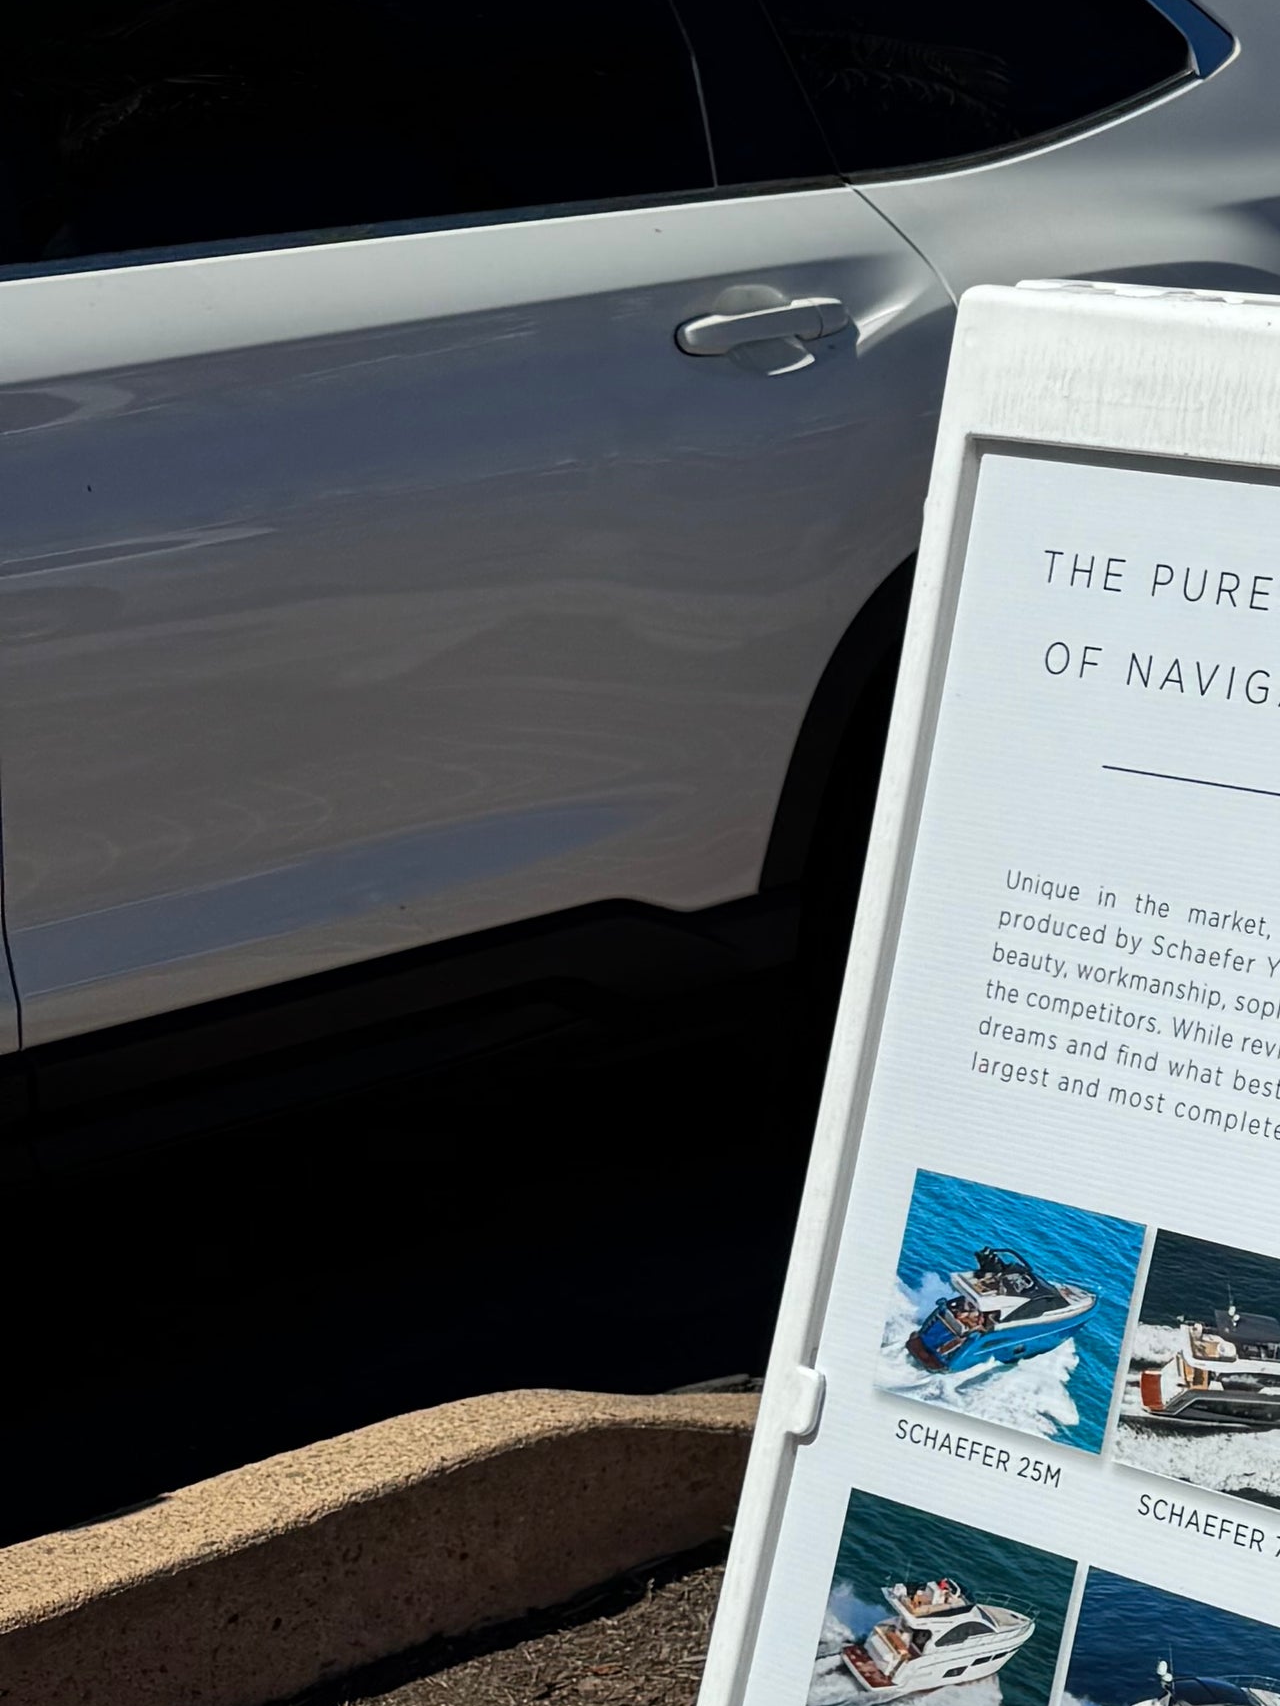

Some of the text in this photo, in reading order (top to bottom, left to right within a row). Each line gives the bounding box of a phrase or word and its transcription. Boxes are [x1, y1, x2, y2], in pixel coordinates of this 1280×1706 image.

[1043, 549, 1127, 593] THE
[1043, 640, 1103, 679] OF
[1005, 868, 1080, 902] Unique
[1097, 884, 1117, 909] in
[1134, 892, 1170, 919] the
[1186, 906, 1271, 941] market,
[991, 940, 1068, 979] beauty,
[1076, 962, 1226, 1011] workmanship,
[997, 910, 1107, 945] produced
[1114, 926, 1143, 956] by
[1150, 934, 1257, 974] Schaefer
[985, 978, 1019, 1005] the
[1025, 991, 1162, 1035] competitors.
[1172, 1016, 1234, 1050] While
[970, 1050, 1050, 1088] largest
[1056, 1075, 1101, 1099] and
[1107, 1086, 1166, 1115] most
[977, 1015, 1058, 1051] dreams
[1065, 1038, 1109, 1062] and
[1115, 1043, 1159, 1072] find
[1167, 1058, 1224, 1088] what
[894, 1418, 1062, 1489] SCHAEFER 25M
[1136, 1493, 1266, 1554] SCHAEFER
